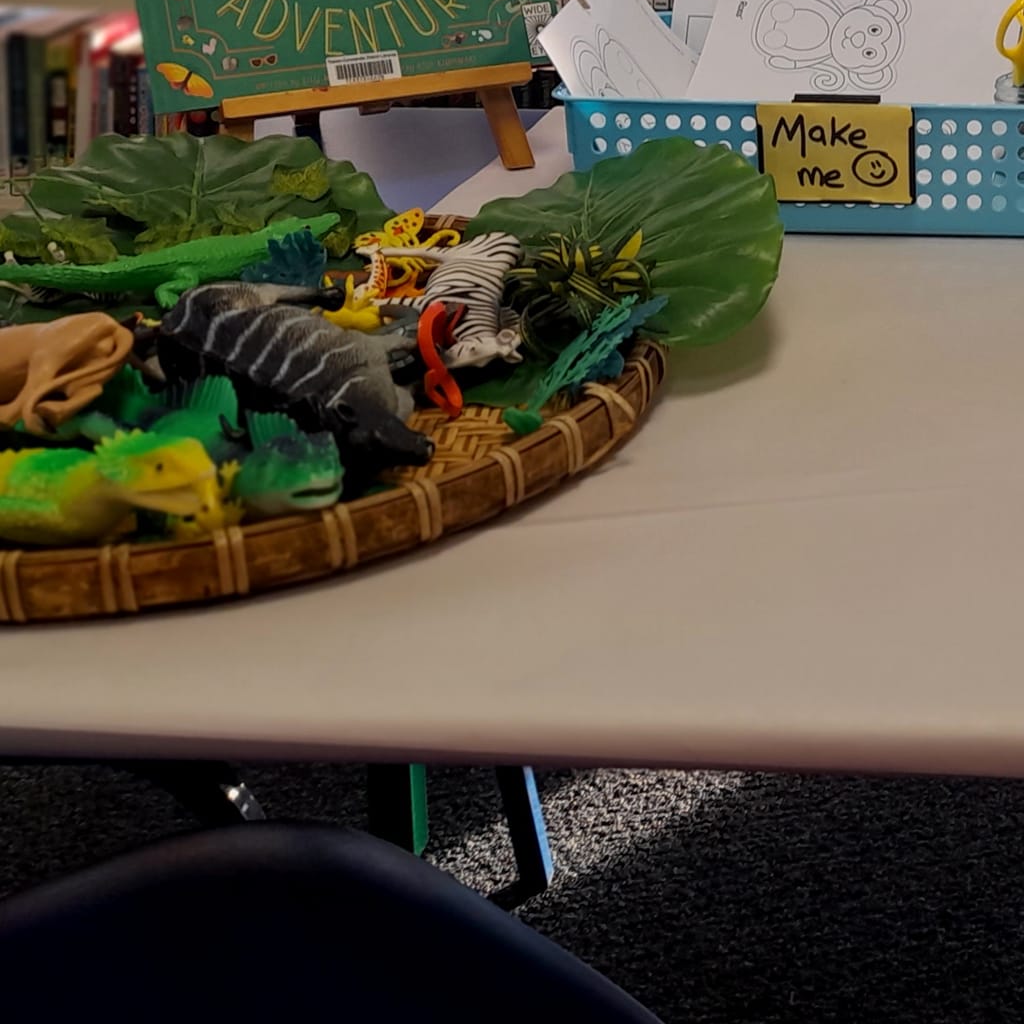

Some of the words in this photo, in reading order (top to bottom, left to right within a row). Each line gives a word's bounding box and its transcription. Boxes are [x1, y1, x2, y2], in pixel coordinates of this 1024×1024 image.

[523, 3, 550, 15] WIDE
[532, 46, 547, 56] EY
[771, 114, 867, 158] Make
[797, 163, 844, 190] me
